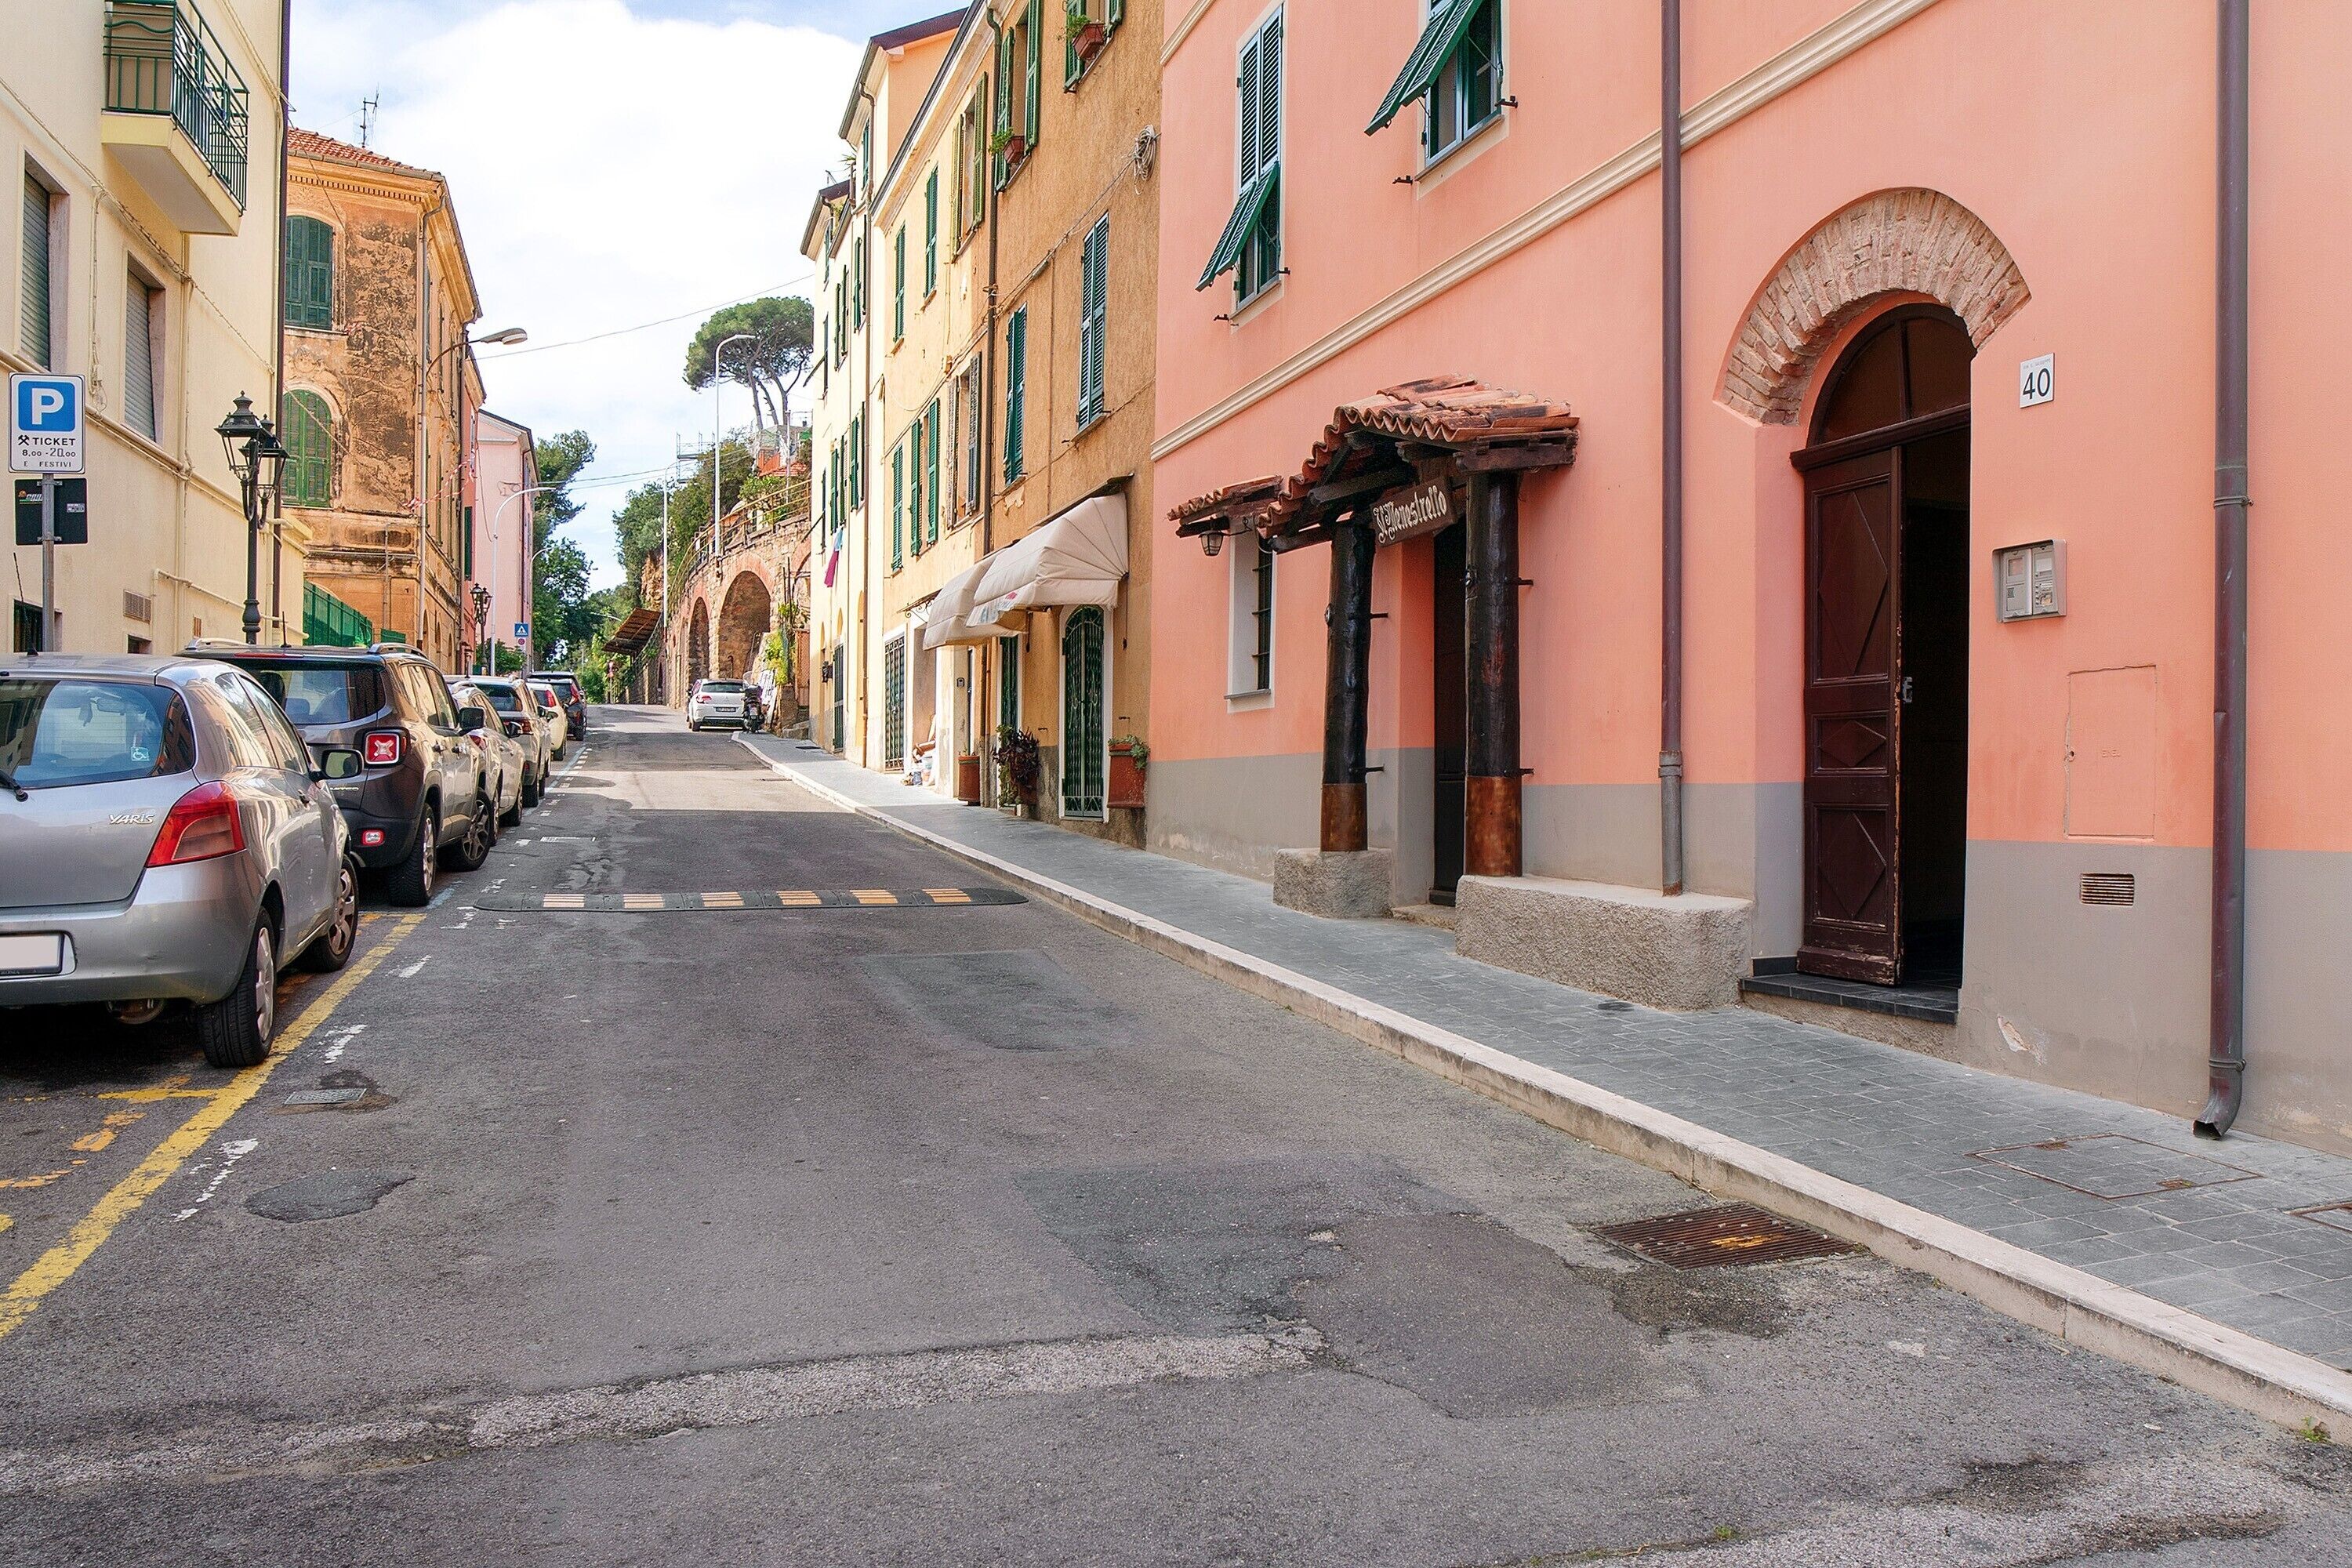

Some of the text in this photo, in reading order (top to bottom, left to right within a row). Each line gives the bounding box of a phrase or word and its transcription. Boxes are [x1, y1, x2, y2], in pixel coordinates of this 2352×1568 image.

[2023, 368, 2050, 399] 40
[31, 387, 64, 425] P
[32, 437, 76, 446] TICKET
[109, 813, 155, 825] YARIS
